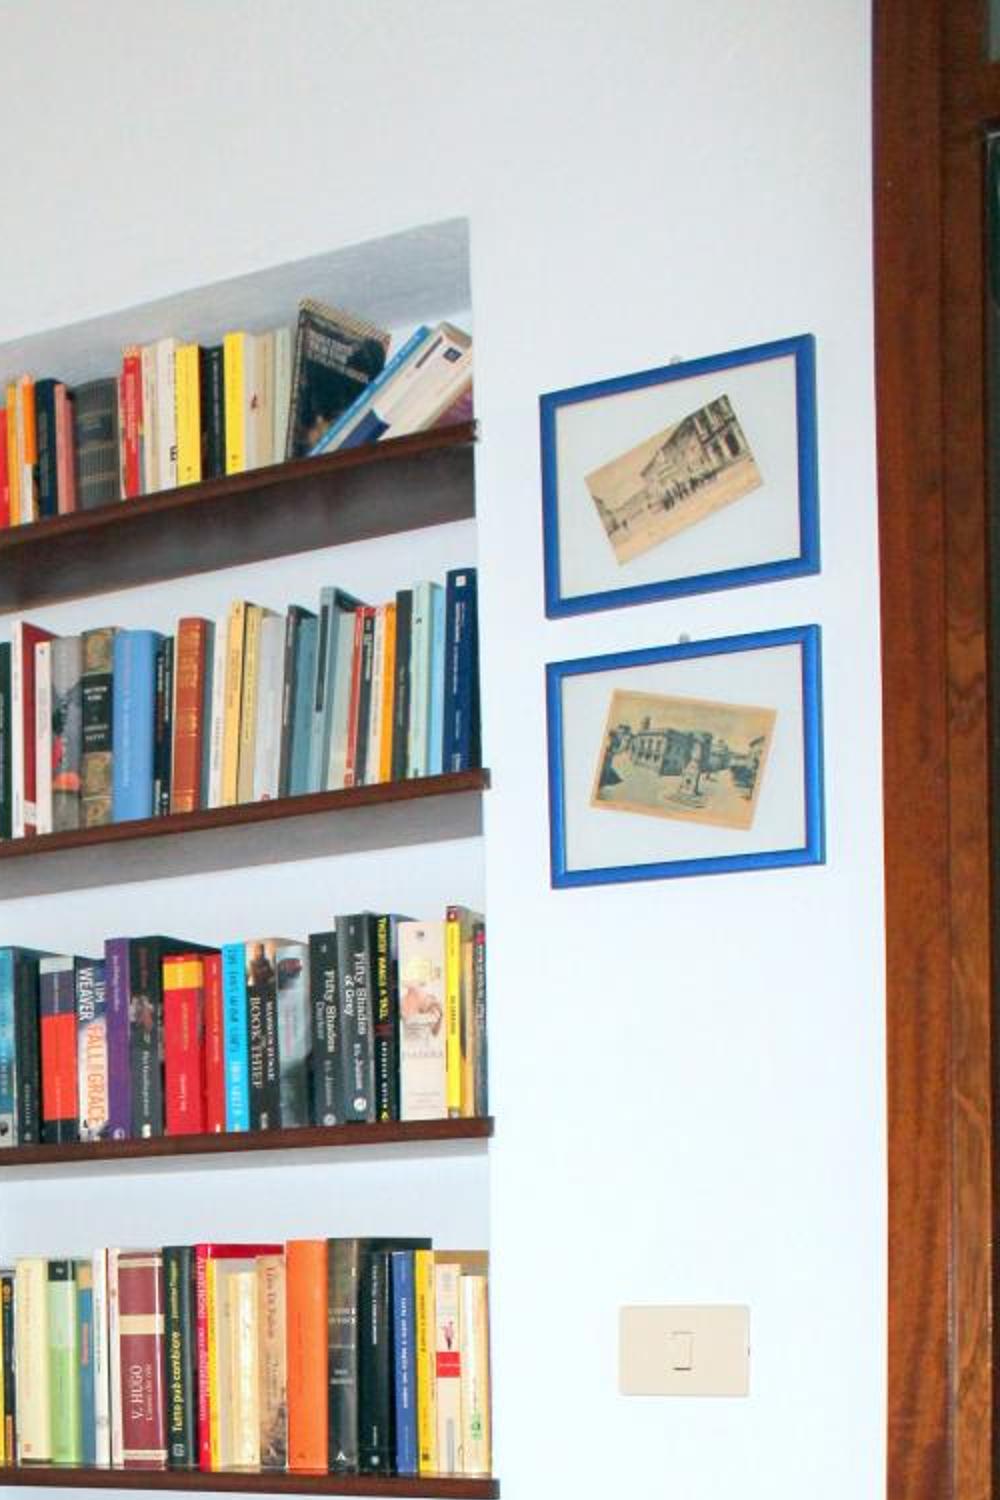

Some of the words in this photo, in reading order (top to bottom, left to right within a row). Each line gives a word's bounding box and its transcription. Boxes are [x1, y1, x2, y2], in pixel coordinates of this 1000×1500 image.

[324, 970, 335, 1002] Fifty
[354, 952, 365, 984] Fifty
[79, 967, 93, 1021] WEAVER
[95, 981, 105, 1003] TIM
[343, 989, 354, 1017] Grey
[356, 987, 368, 1035] Shades
[250, 996, 262, 1041] BOOK
[326, 1005, 337, 1053] Shades
[251, 1046, 263, 1089] THIEF
[88, 1073, 104, 1123] GRACE
[131, 1365, 143, 1403] HUGO
[132, 1407, 144, 1418] V.
